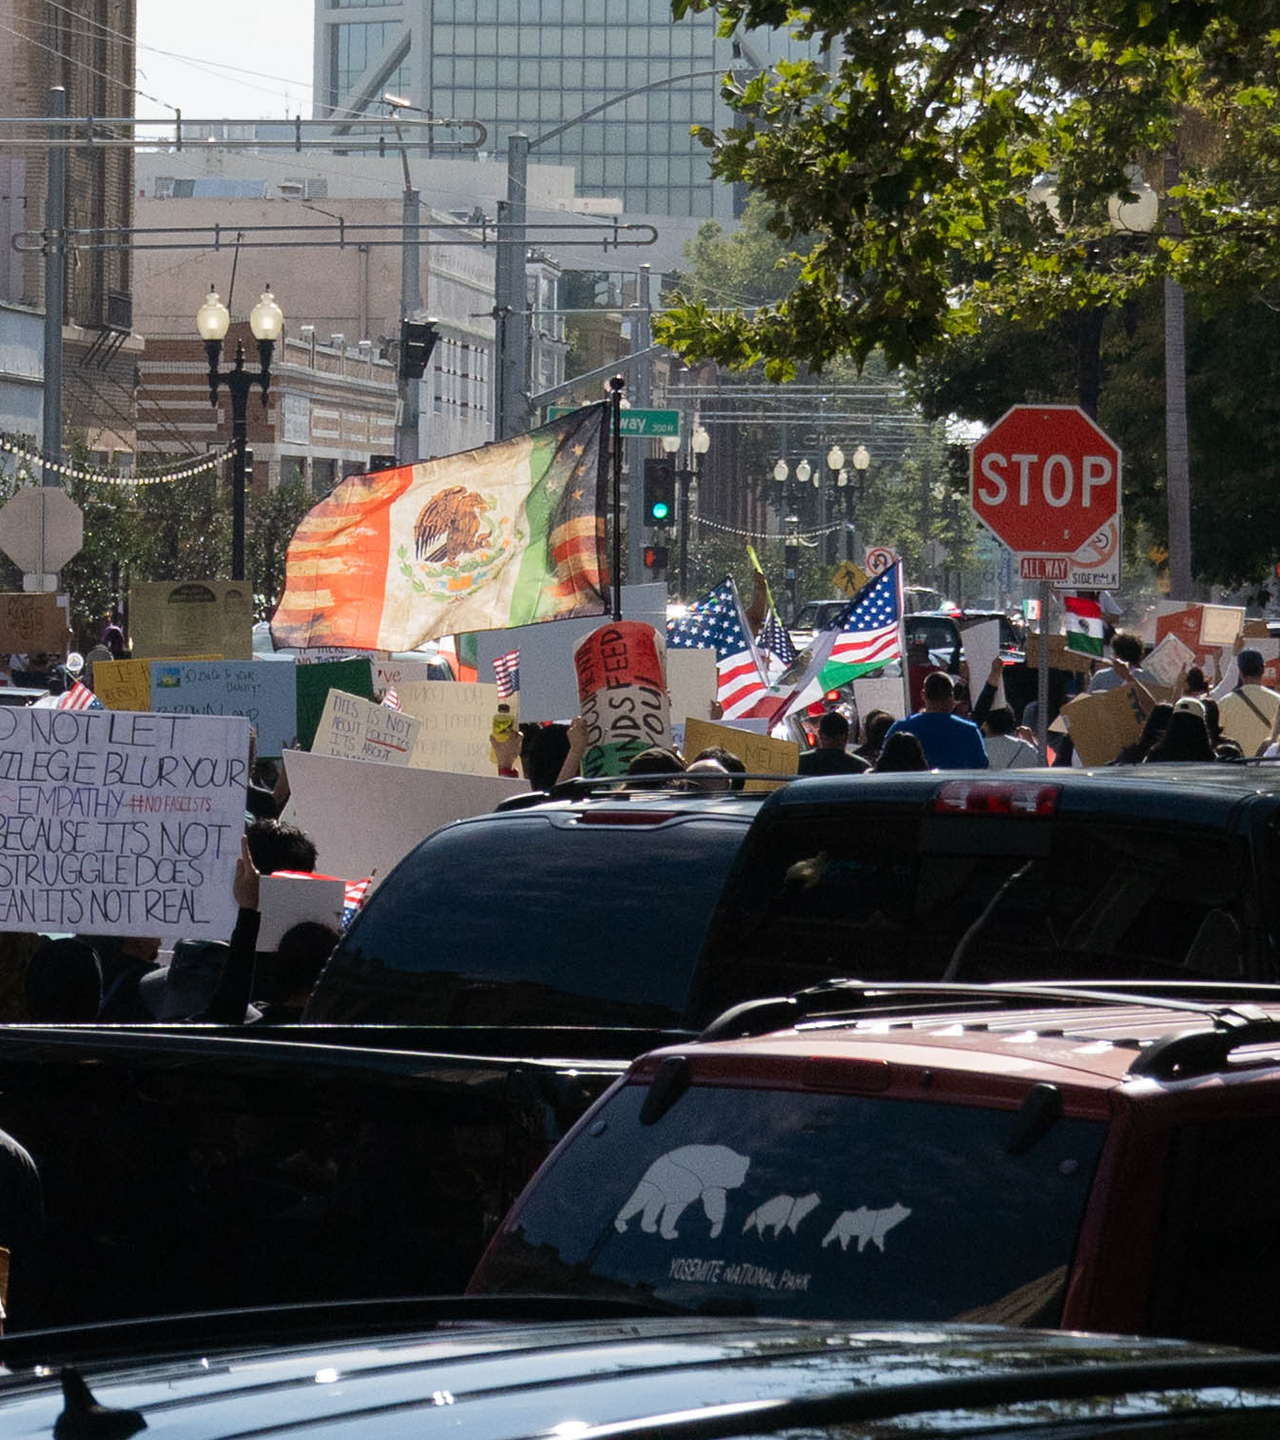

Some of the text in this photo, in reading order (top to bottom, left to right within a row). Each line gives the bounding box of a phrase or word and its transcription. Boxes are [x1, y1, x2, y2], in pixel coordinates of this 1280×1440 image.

[977, 452, 1113, 508] STOP
[1022, 559, 1066, 577] ALL WAY
[601, 629, 631, 691] FEED
[30, 712, 101, 745] NOT
[107, 713, 191, 750] LET
[333, 695, 412, 737] THIS IS NOT
[360, 741, 392, 761] ABOUT
[103, 751, 178, 789] BLUR
[182, 756, 246, 789] YOUR
[17, 785, 126, 817] EMPATHY
[96, 821, 150, 856] ITS
[160, 821, 231, 859] NOT
[135, 855, 205, 887] DOES
[38, 889, 83, 924] ITS
[90, 889, 141, 923] NOT
[144, 890, 211, 924] REAL
[668, 1256, 812, 1291] YOSEMITE NATIONAL PARK
